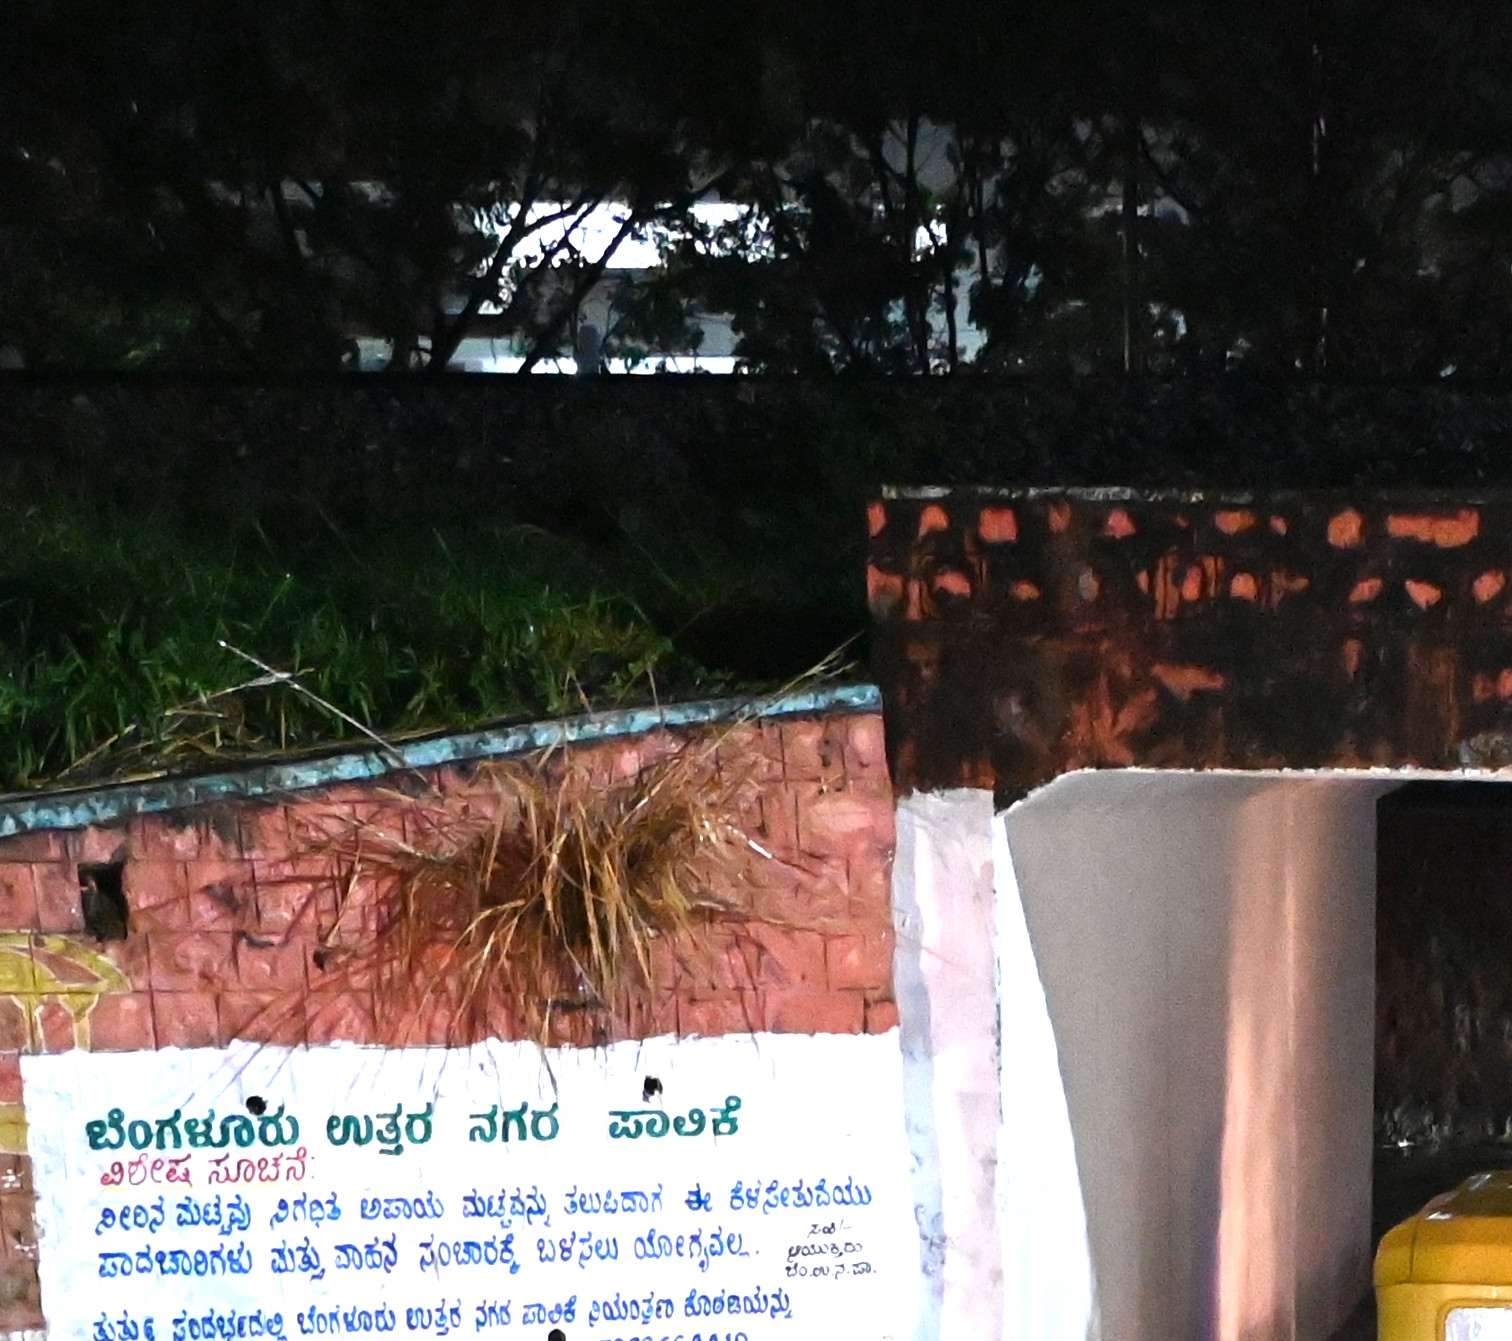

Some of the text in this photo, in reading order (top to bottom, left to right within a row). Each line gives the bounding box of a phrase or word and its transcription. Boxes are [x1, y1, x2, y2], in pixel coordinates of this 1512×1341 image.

[326, 1101, 434, 1156] ಉತ್ತರ
[469, 1101, 560, 1143] ನಗರ
[608, 1095, 742, 1140] ಪಾಲಿಕೆ
[360, 1190, 444, 1220] ಅಪಾಯ
[334, 1232, 398, 1274] ವಾಹನ
[406, 1298, 461, 1336] ಉತ್ತರ
[475, 1299, 511, 1333] ನಗರ
